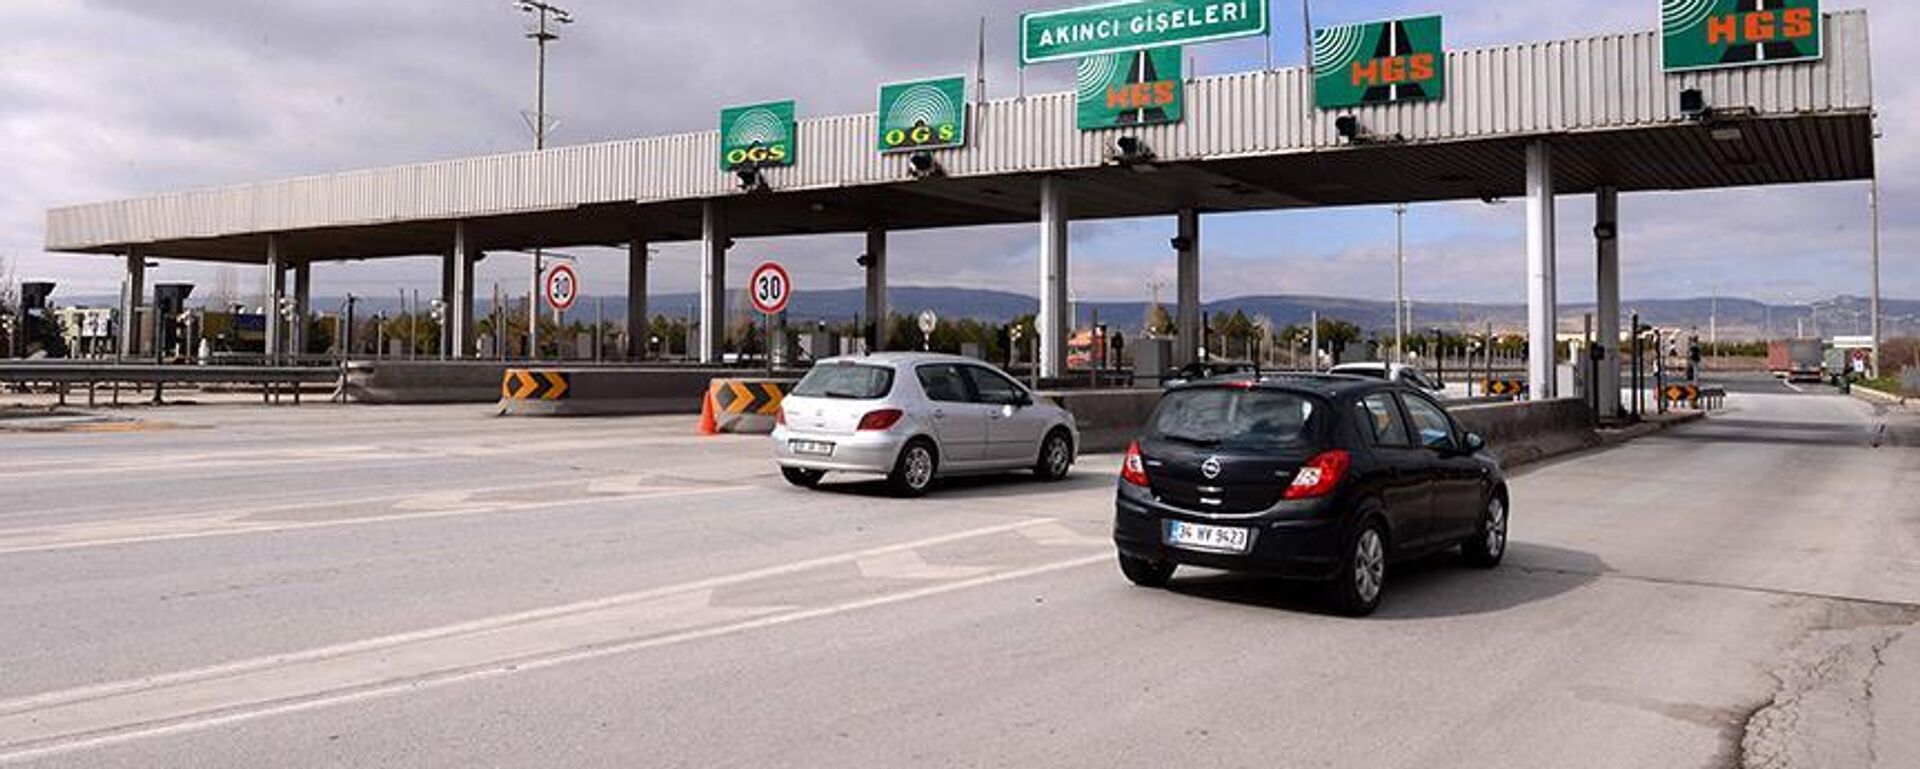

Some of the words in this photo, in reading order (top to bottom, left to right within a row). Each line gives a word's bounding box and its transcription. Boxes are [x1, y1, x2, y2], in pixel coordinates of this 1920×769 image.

[1039, 23, 1119, 47] AKINCI
[1708, 8, 1812, 44] HGS
[1352, 53, 1434, 86] HGS
[1106, 80, 1174, 108] HGS
[885, 124, 954, 145] OGS
[727, 144, 785, 164] OGS
[553, 276, 570, 299] 30
[758, 275, 781, 301] 30
